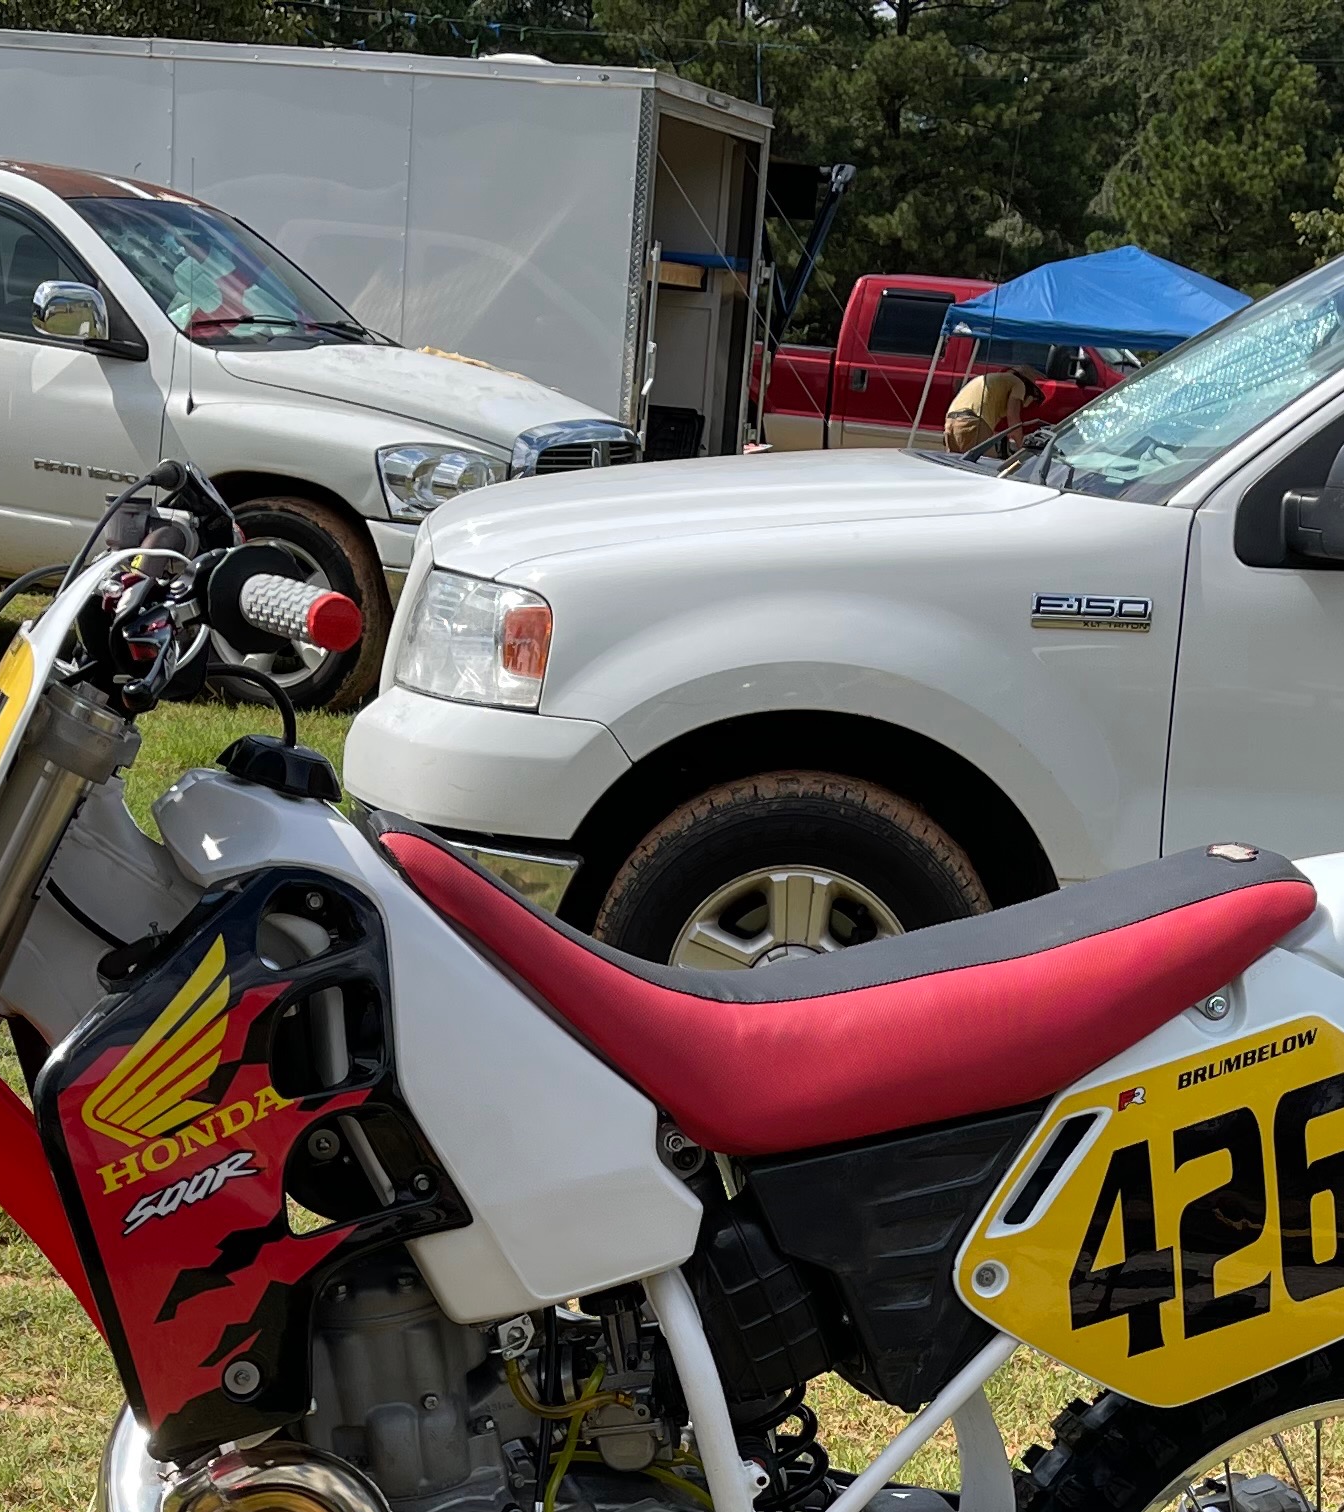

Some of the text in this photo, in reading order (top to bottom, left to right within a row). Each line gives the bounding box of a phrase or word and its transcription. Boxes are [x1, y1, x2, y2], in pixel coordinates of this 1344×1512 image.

[34, 458, 81, 477] RAM
[1107, 620, 1149, 630] TRITON
[1177, 1028, 1318, 1090] BRUMBELOW
[96, 1085, 294, 1195] HONDA
[122, 1151, 260, 1236] 500R
